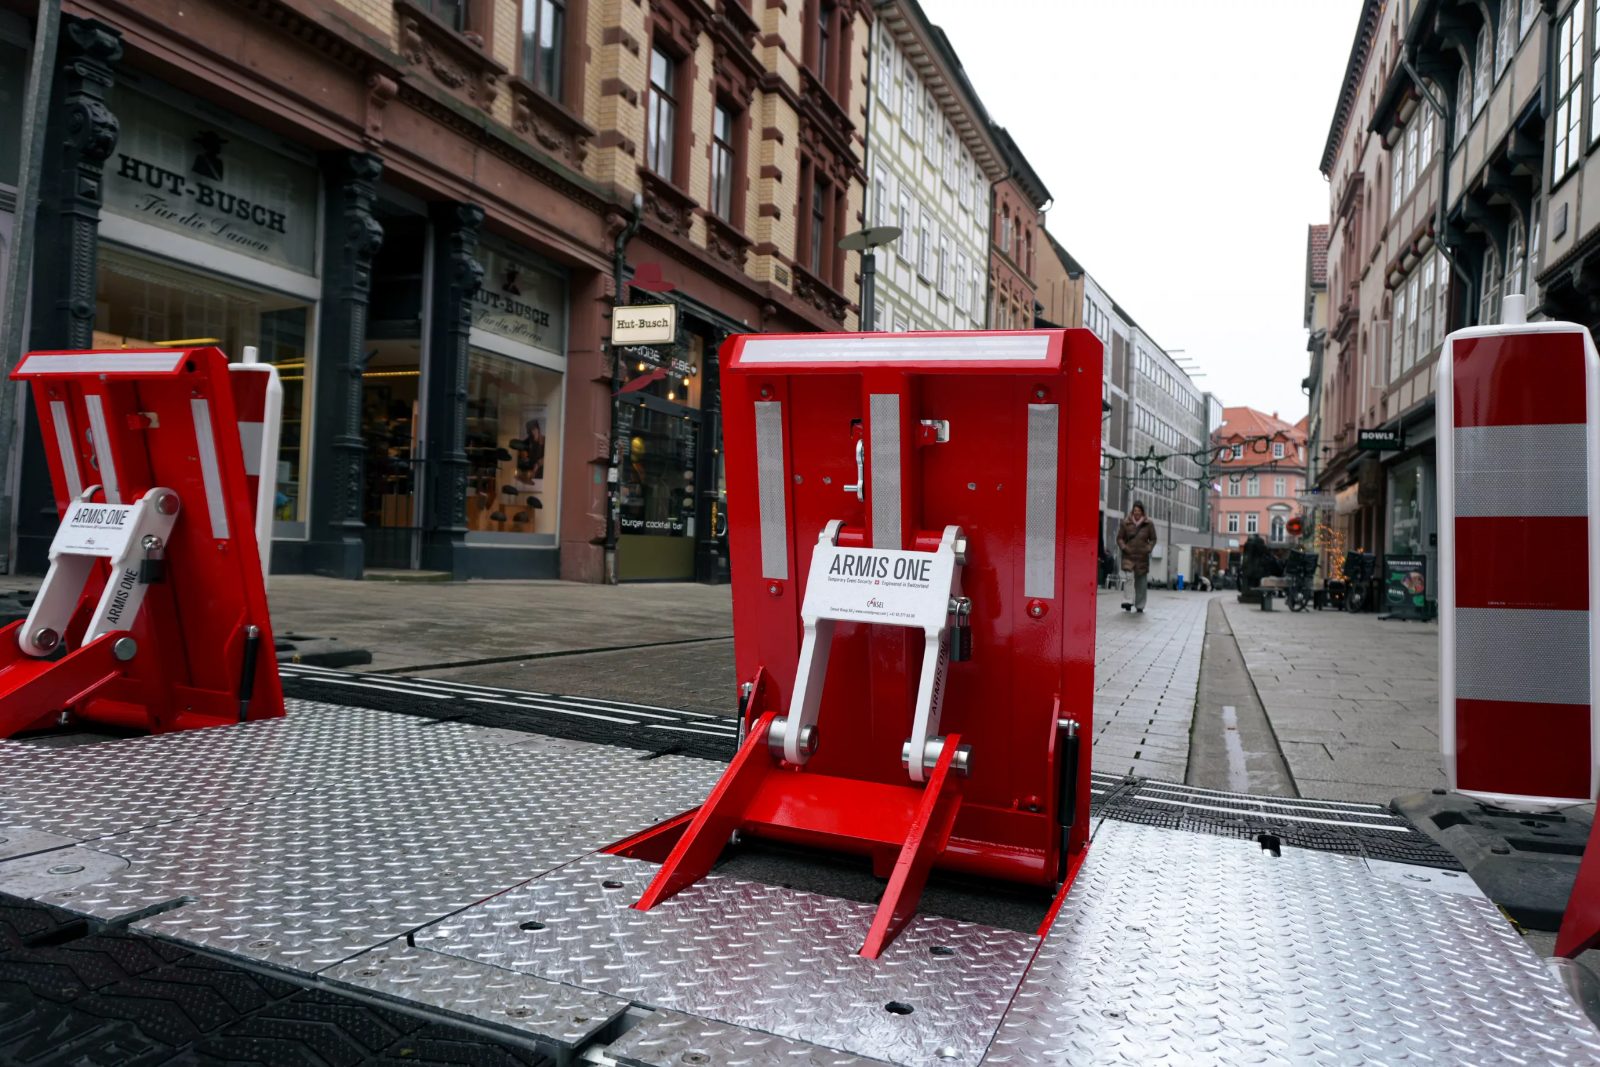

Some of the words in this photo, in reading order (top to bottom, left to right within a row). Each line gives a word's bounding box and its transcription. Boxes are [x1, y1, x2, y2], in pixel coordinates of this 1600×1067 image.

[117, 153, 287, 234] HUT-BUSCH
[178, 211, 207, 230] die
[616, 317, 669, 330] Hut-Busch
[1361, 432, 1395, 441] BOWLS
[72, 507, 107, 524] ARMIS
[105, 509, 130, 525] ONE
[621, 517, 644, 528] burger
[672, 521, 683, 530] bar
[829, 553, 889, 579] ARMIS
[893, 557, 932, 582] ONE
[107, 589, 129, 624] ARMIS
[121, 567, 138, 591] ONE
[931, 668, 943, 715] ARMIS
